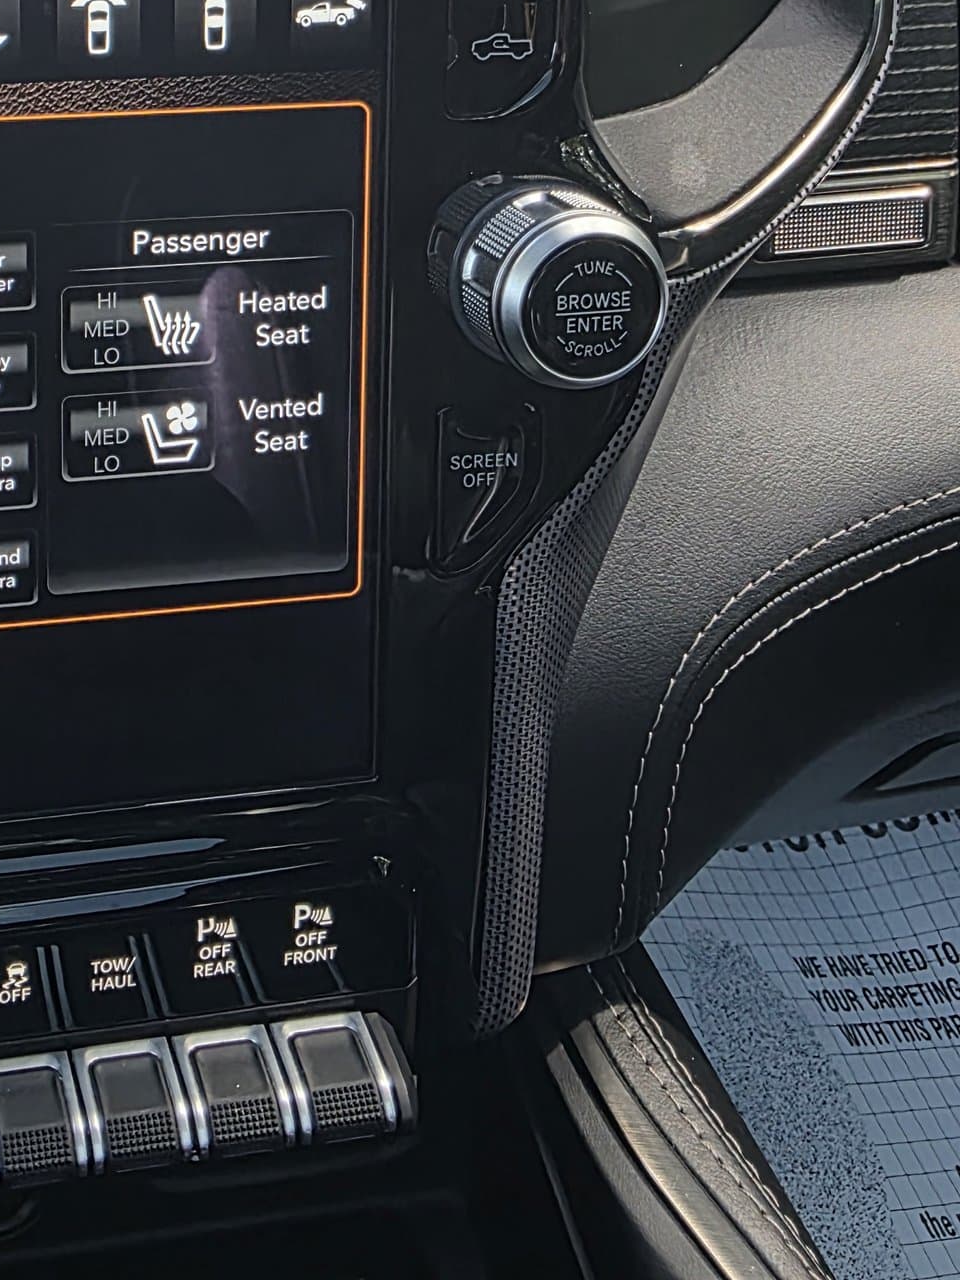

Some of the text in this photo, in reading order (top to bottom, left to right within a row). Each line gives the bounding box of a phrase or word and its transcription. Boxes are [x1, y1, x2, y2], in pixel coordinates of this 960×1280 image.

[132, 229, 271, 257] Passenger
[574, 260, 615, 278] TUNE
[97, 291, 117, 310] HI
[239, 285, 328, 314] Heated
[556, 290, 632, 311] BROWSE
[84, 318, 130, 339] MED
[565, 315, 624, 334] ENTER
[255, 324, 310, 347] Seat
[93, 347, 120, 366] LO
[564, 337, 622, 358] SCROLL
[97, 400, 117, 419] HI
[239, 392, 324, 421] Vented
[84, 427, 130, 447] MED
[254, 430, 309, 454] Seat
[93, 455, 120, 474] LO
[450, 452, 518, 471] SCREEN
[462, 472, 496, 488] OFF
[295, 929, 327, 947] OFF
[199, 943, 231, 960] OFF
[283, 946, 337, 966] FRONT
[792, 941, 960, 979] WE HAVE TRIED TO
[90, 956, 136, 975] TOW/
[193, 959, 235, 978] REAR
[91, 974, 137, 993] HAUL
[808, 977, 960, 1013] YOUR CARPETING
[837, 1021, 890, 1047] WITH
[881, 1017, 932, 1044] THIS
[920, 1210, 957, 1239] the
